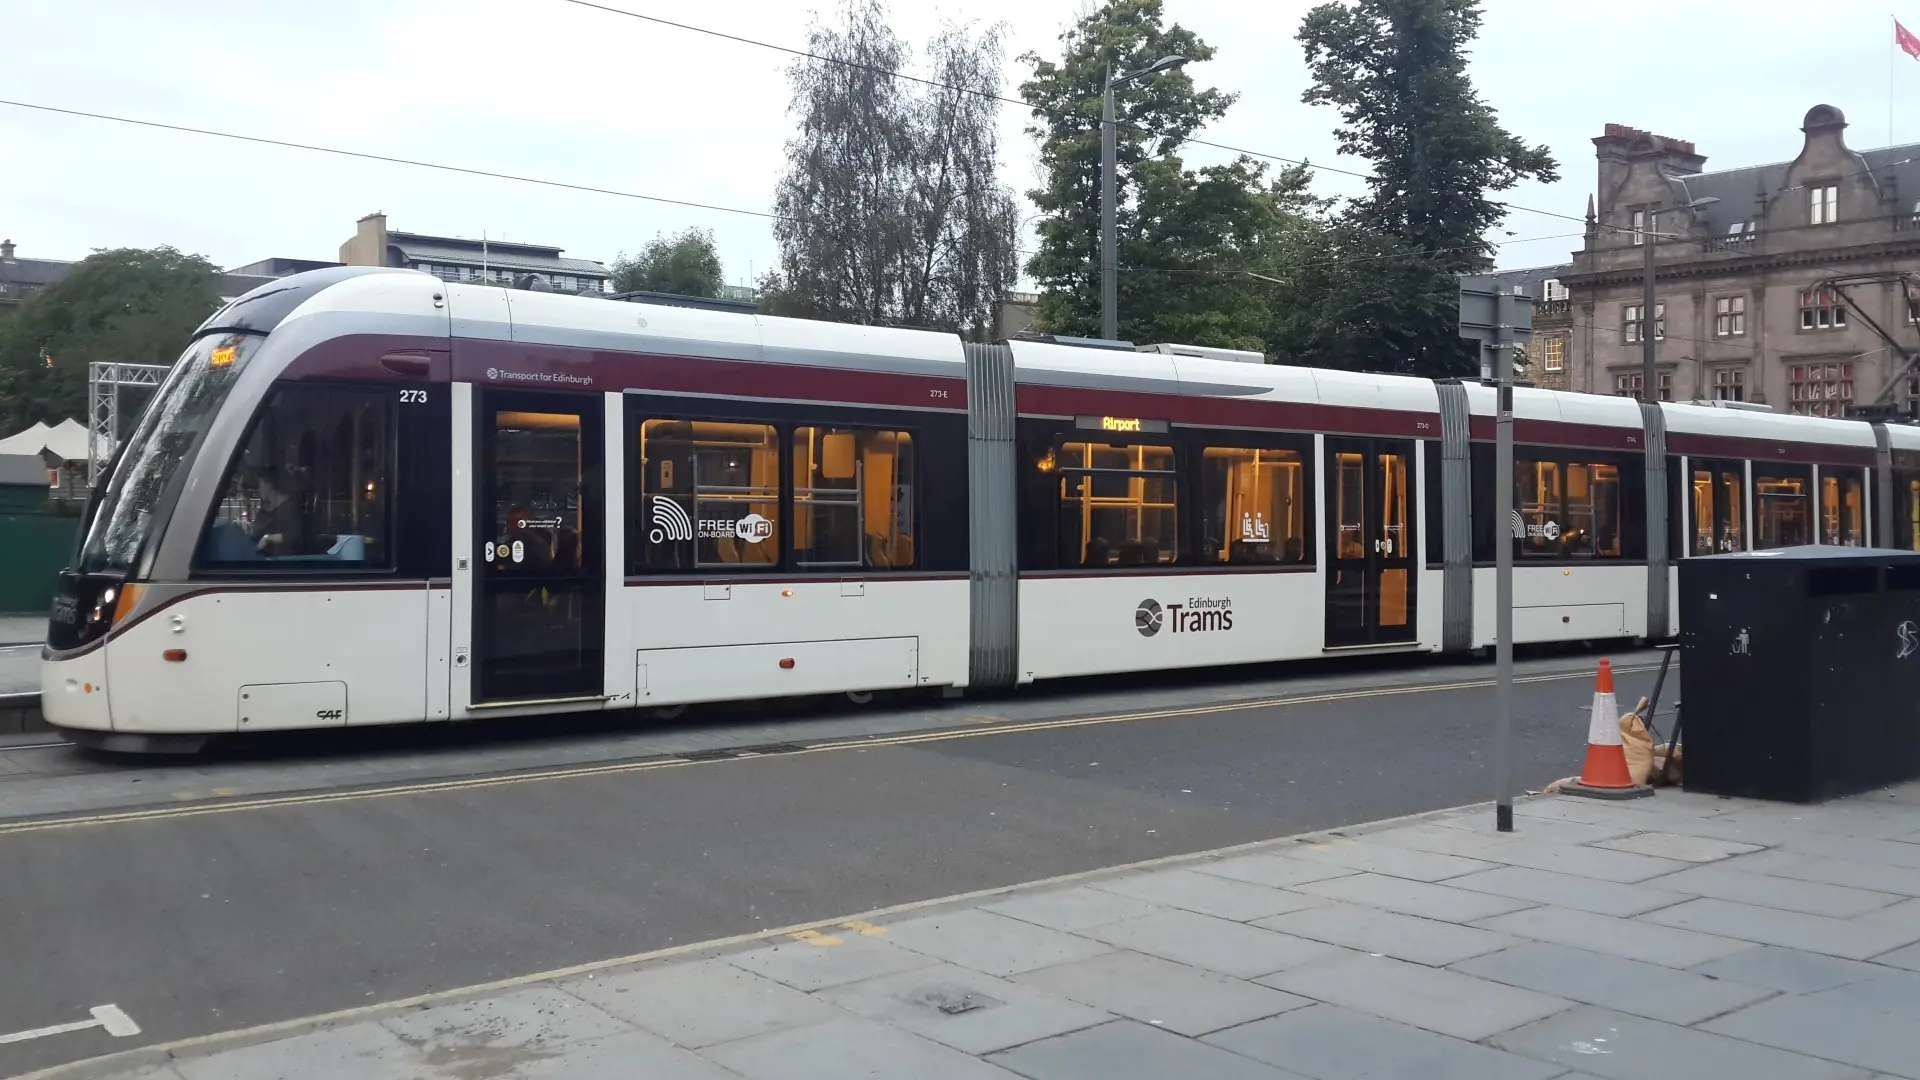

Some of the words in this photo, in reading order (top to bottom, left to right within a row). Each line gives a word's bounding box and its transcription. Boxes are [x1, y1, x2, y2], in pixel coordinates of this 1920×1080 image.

[499, 369, 538, 381] Transport
[540, 373, 552, 381] for
[553, 373, 593, 385] Edinburgh
[399, 389, 428, 403] 273
[930, 389, 948, 399] 273-E
[1103, 416, 1140, 431] Airport
[698, 520, 735, 531] FREE
[1527, 524, 1544, 532] FREE
[1189, 596, 1232, 610] Edinburgh
[1166, 604, 1233, 633] Trams
[316, 709, 343, 721] CAF
